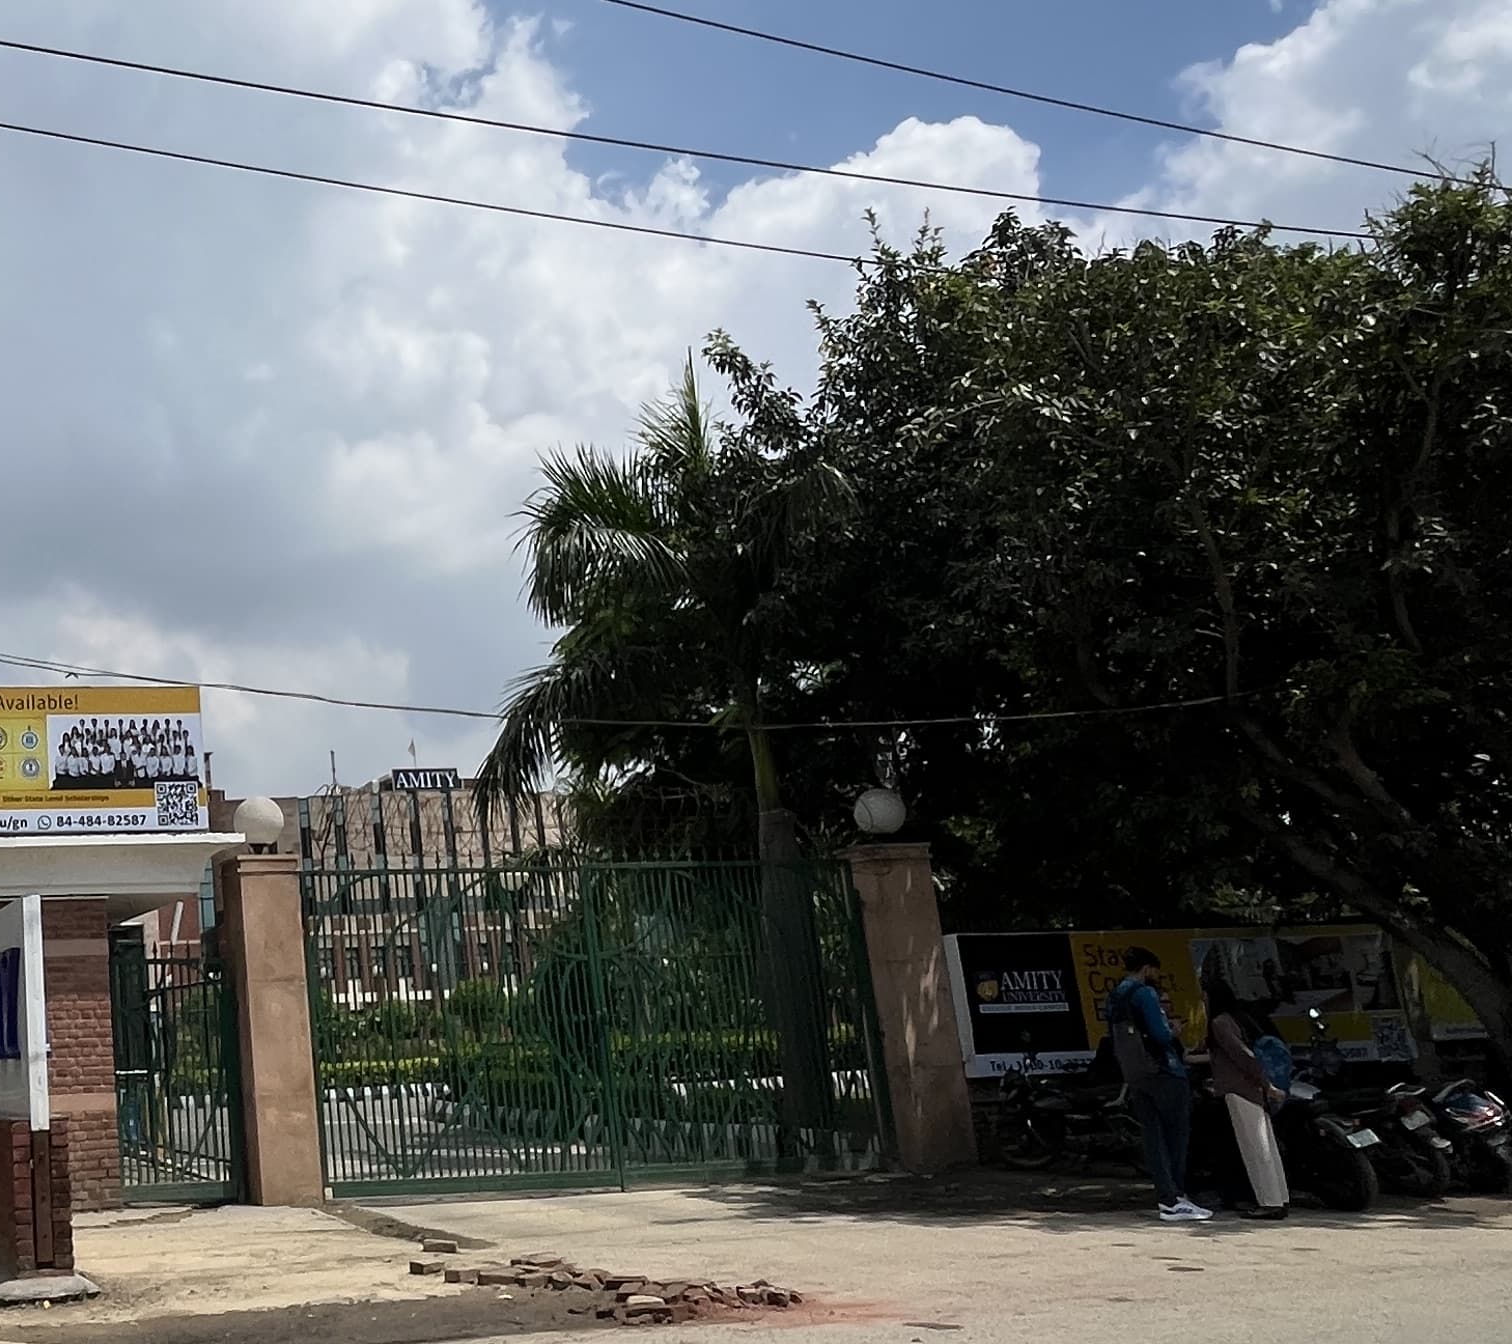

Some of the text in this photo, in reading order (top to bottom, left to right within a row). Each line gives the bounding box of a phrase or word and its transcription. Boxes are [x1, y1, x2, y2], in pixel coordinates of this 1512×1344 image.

[396, 771, 455, 788] AMITY
[56, 814, 147, 828] 84-484-82587
[1000, 969, 1063, 991] AMITY
[1002, 990, 1067, 1002] UNIVERSITY
